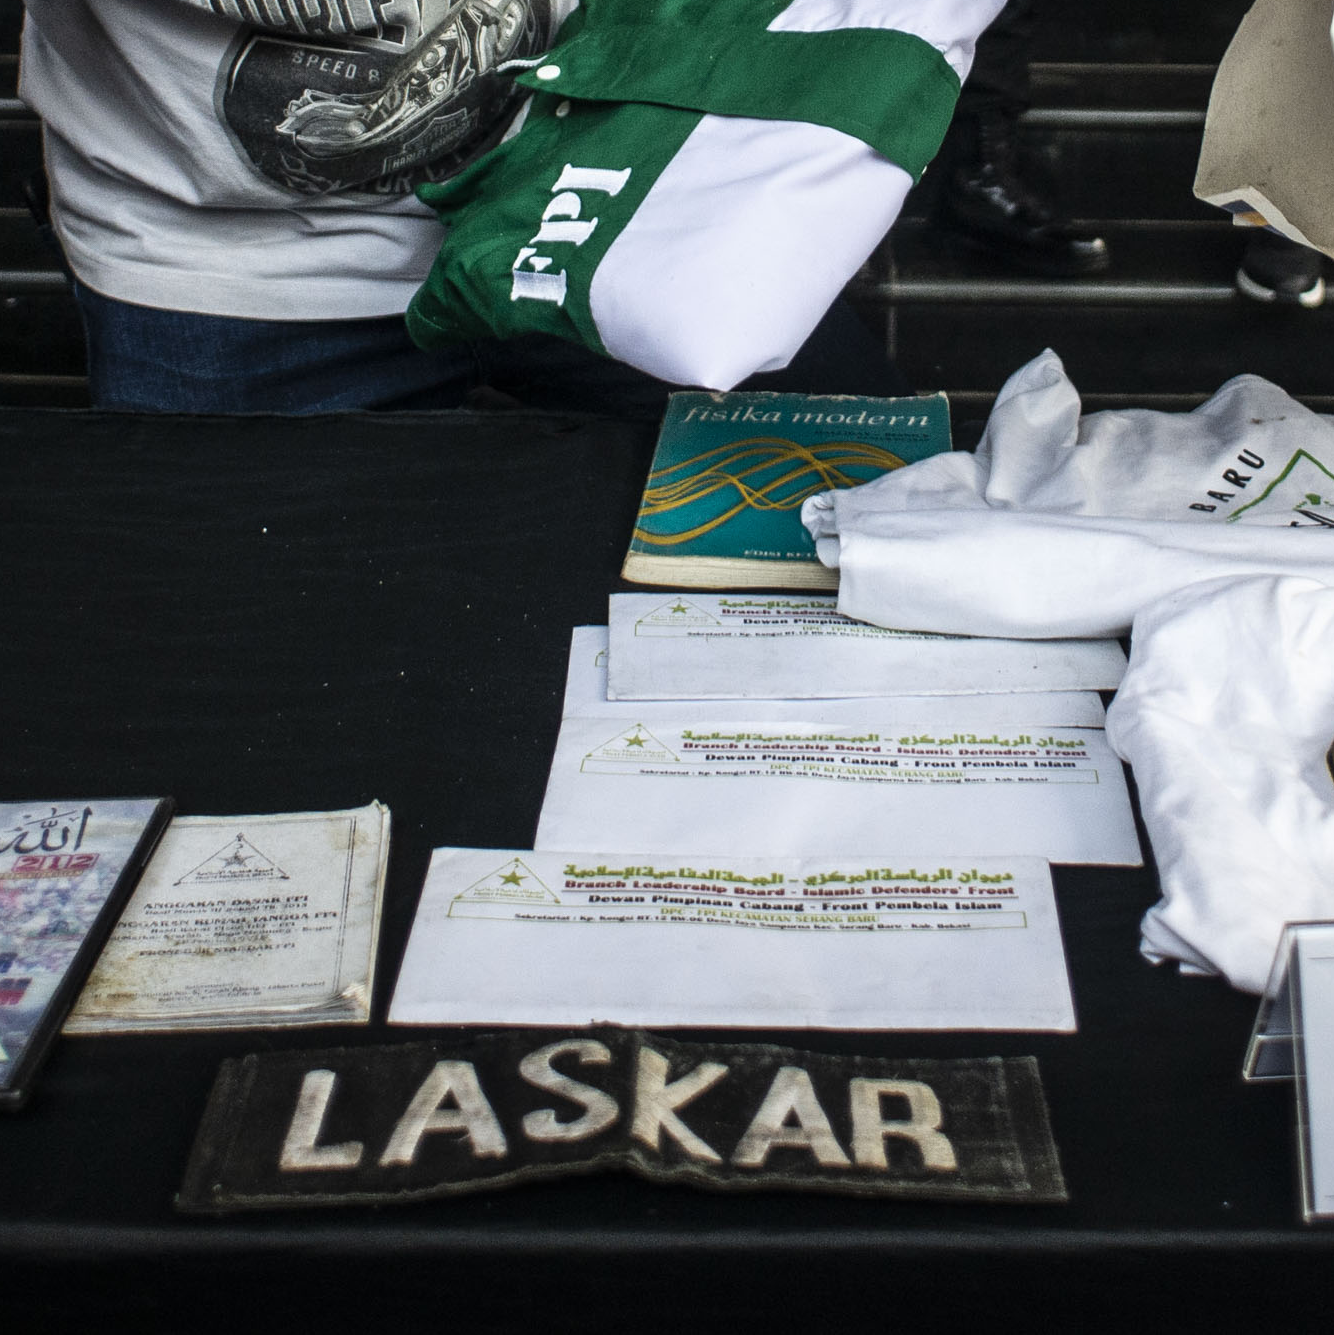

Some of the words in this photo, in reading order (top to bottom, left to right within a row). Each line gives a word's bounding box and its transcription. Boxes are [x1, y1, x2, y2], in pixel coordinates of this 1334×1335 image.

[290, 49, 358, 80] SPEED
[509, 162, 632, 308] FPI
[683, 406, 781, 424] fisika
[790, 409, 932, 428] modern
[1188, 448, 1267, 514] BARU
[682, 742, 739, 750] Branch
[744, 743, 830, 752] Leadership
[834, 744, 882, 753] Board
[897, 747, 954, 756] Islamic
[958, 748, 1040, 756] Defenders'
[1045, 749, 1087, 757] Front
[705, 753, 756, 762] Dewan
[761, 754, 835, 765] Pimpinan
[840, 757, 899, 768] Cabang
[914, 760, 957, 768] Front
[962, 760, 1029, 769] Pembela
[1034, 760, 1077, 769] Islam
[15, 853, 97, 870] 212
[565, 879, 627, 889] Branch
[632, 880, 727, 894] Leadership
[733, 886, 786, 896] Board
[802, 887, 866, 896] Islamic
[871, 886, 962, 896] Defenders'
[968, 886, 1015, 896] Front
[588, 894, 642, 904] Dewan
[651, 894, 734, 907] Pimpinan
[739, 900, 804, 912] Cabang
[821, 902, 869, 911] Front
[875, 902, 949, 911] Pembela
[955, 901, 1003, 911] Islam
[117, 920, 191, 930] NGGARAN
[278, 1037, 960, 1173] LASKAR
